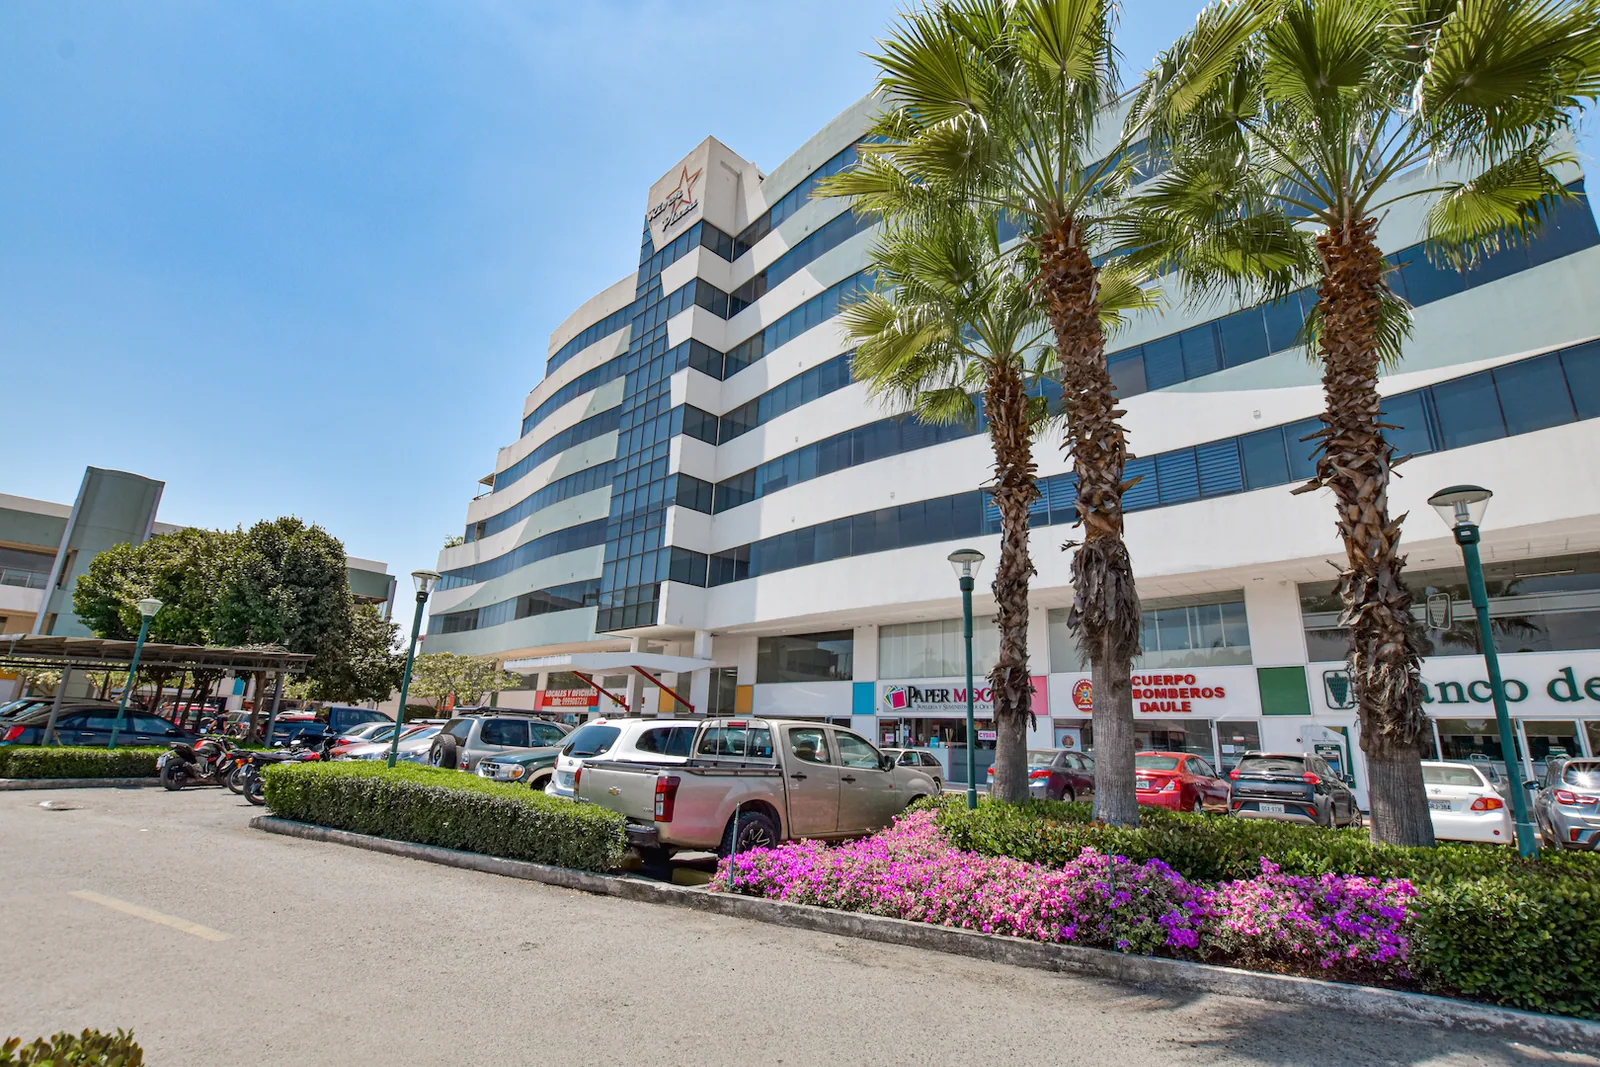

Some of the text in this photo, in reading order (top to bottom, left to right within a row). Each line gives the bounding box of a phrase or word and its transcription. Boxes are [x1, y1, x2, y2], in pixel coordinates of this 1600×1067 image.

[1131, 674, 1196, 687] CUERPO
[1547, 666, 1600, 702] de
[907, 686, 951, 708] PAPER
[1132, 687, 1225, 700] BOMBEROS
[1140, 701, 1192, 713] DAULE
